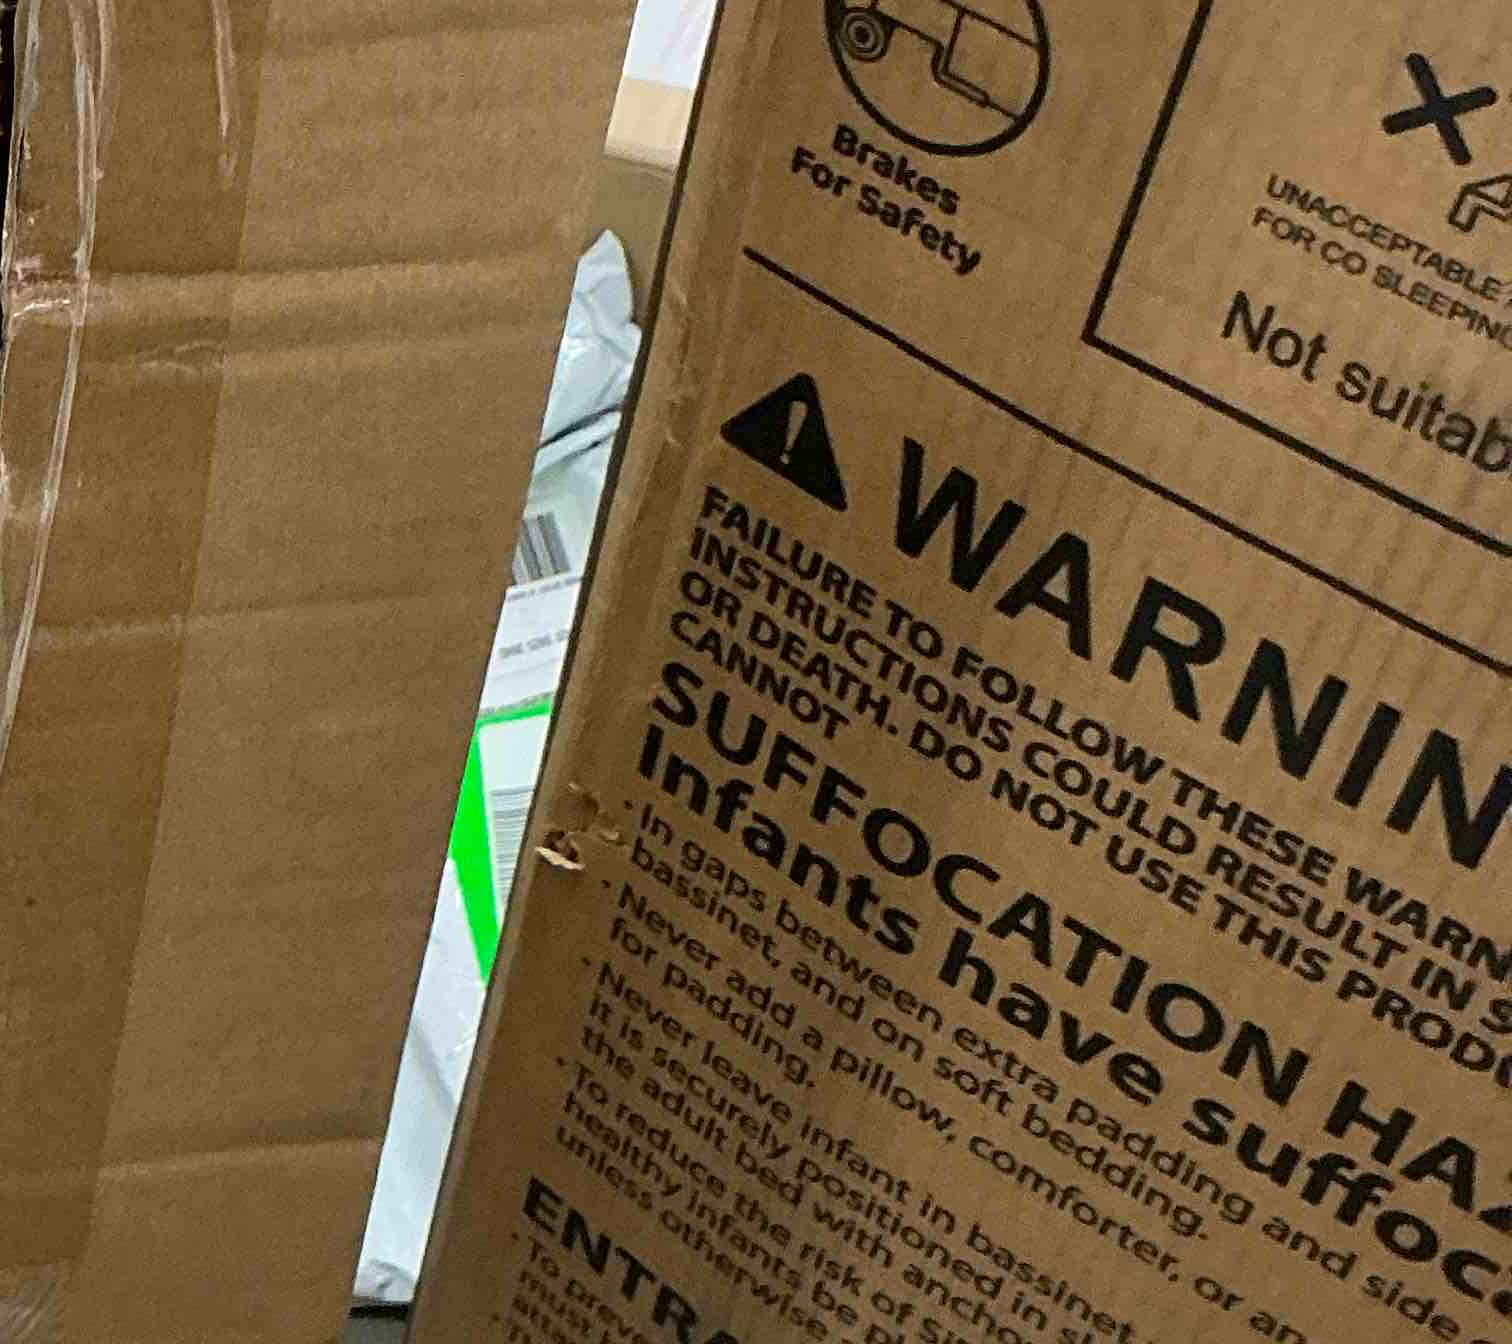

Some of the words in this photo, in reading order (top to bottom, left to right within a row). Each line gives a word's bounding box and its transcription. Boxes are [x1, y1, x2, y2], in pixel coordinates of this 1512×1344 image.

[791, 146, 854, 206] For
[859, 188, 983, 276] Safety
[833, 123, 960, 216] Brakes
[1251, 205, 1317, 253] FOR
[1320, 239, 1368, 276] CO
[1266, 173, 1503, 302] UNACCEPTABLE
[1221, 289, 1328, 383] Not
[668, 609, 850, 741] CANNOT
[678, 570, 742, 628] OR
[747, 610, 899, 736] DEATH.
[907, 718, 982, 783] DO
[989, 767, 1100, 847] NOT
[1104, 833, 1206, 916] USE
[1213, 893, 1332, 983] THIS
[688, 526, 1014, 753] INSTRUCTIONS
[1021, 740, 1197, 855] COULD
[1204, 843, 1408, 969] RESULT
[1409, 957, 1476, 1011] IN
[698, 484, 878, 620] FAILURE
[884, 598, 944, 660] TO
[950, 645, 1166, 785] FOLLOW
[1170, 766, 1338, 887] THESE
[608, 915, 658, 965] for
[660, 961, 815, 1089] padding.
[629, 834, 793, 969] bassinet,
[789, 960, 866, 1023] and
[870, 1016, 925, 1063] on
[932, 1055, 1014, 1117] soft
[1019, 1102, 1208, 1241] bedding.
[636, 722, 920, 955] Infants
[937, 926, 1164, 1107] have
[1180, 1097, 1512, 1316] suffoc
[639, 802, 673, 847] In
[679, 839, 766, 913] gaps
[774, 897, 943, 1033] between
[952, 1026, 1059, 1104] extra
[1064, 1096, 1255, 1225] padding
[1260, 1215, 1358, 1281] and
[1361, 1274, 1461, 1342] side
[650, 661, 1311, 1108] SUFFOCATION
[1321, 1079, 1512, 1240] HA
[558, 1089, 687, 1197] healthy
[685, 1189, 801, 1290] infants
[810, 1279, 859, 1326] be
[574, 1062, 609, 1106] To
[614, 1102, 726, 1199] reduce
[734, 1191, 792, 1249] the
[798, 1242, 863, 1297] risk
[869, 1289, 914, 1325] of
[580, 1025, 635, 1081] the
[640, 1076, 729, 1153] adult
[734, 1140, 805, 1209] bed
[812, 1201, 893, 1269] with
[596, 961, 697, 1048] Never
[700, 1039, 793, 1125] leave
[798, 1114, 911, 1205] infant
[918, 1191, 956, 1235] in
[617, 881, 721, 971] Never
[724, 968, 797, 1030] add
[800, 1024, 824, 1053] a
[828, 1044, 957, 1143] pillow,
[967, 1134, 1180, 1283] comforter,
[1193, 1275, 1245, 1312] or
[617, 1014, 644, 1051] is
[644, 1046, 793, 1160] securely
[794, 1156, 1005, 1301] positioned
[1010, 1290, 1048, 1331] in
[555, 1124, 653, 1211] unless
[658, 1208, 829, 1342] otherwise
